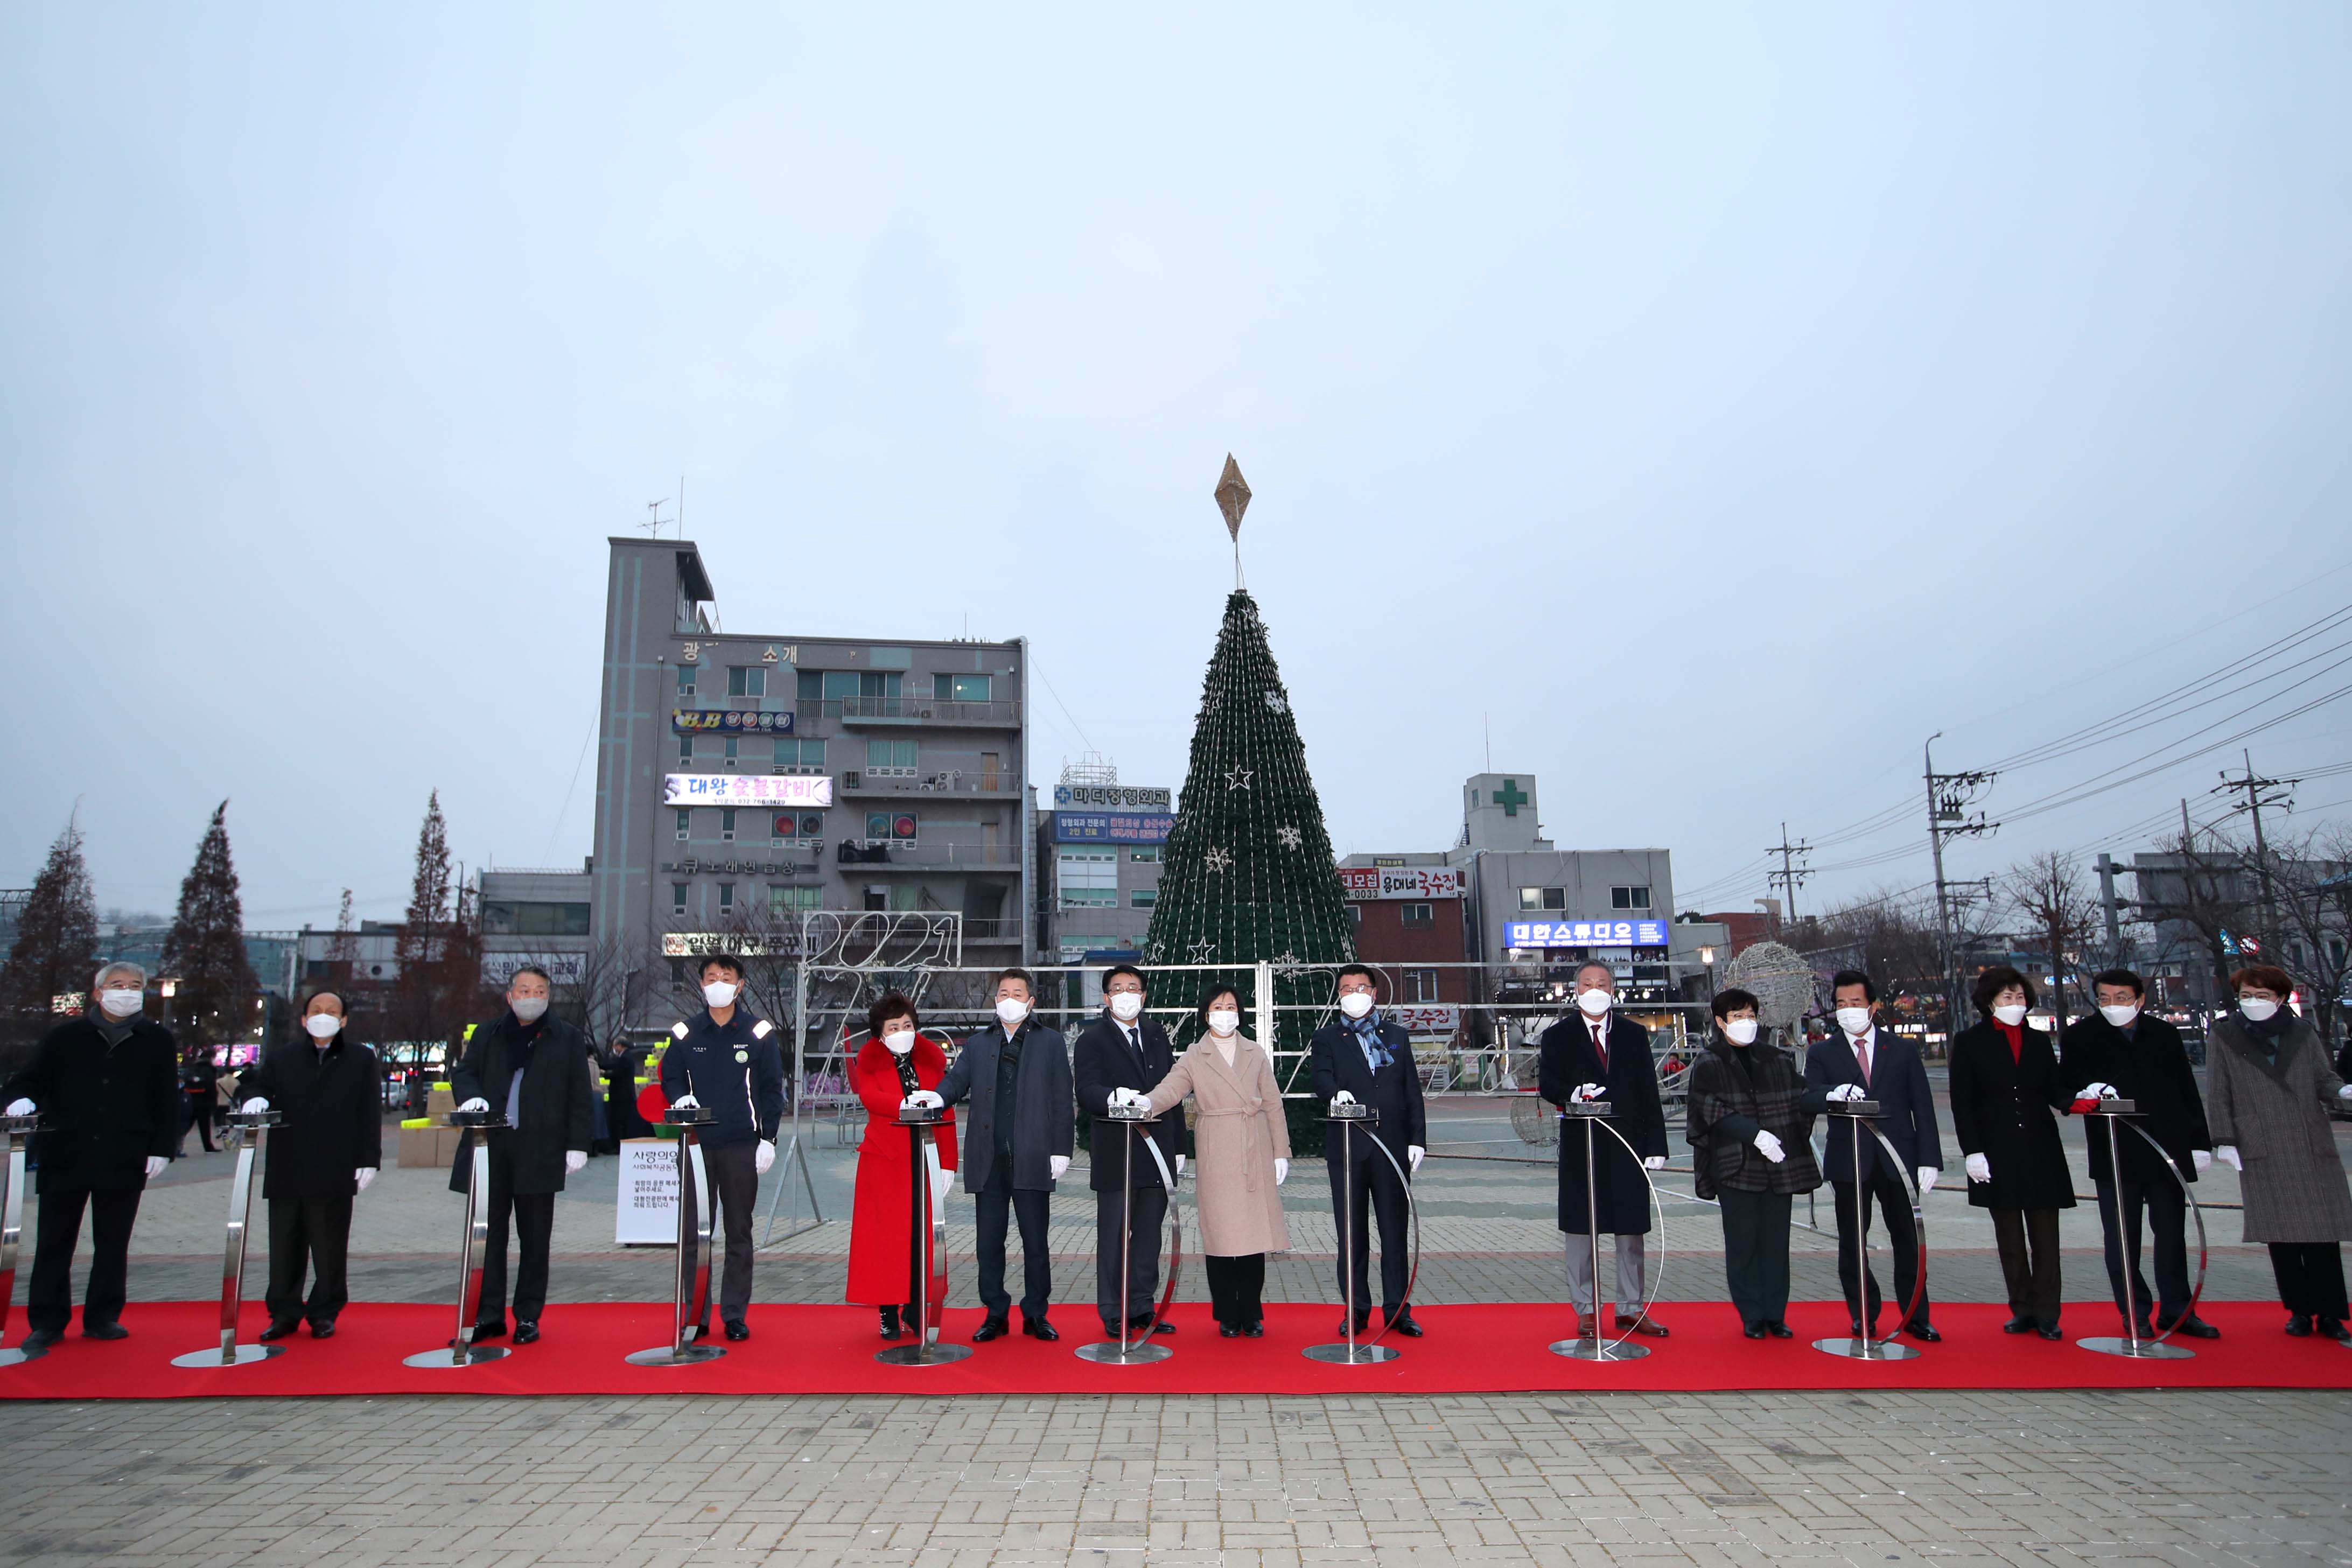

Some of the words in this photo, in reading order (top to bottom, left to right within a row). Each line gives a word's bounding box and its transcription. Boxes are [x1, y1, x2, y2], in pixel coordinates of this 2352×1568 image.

[688, 778, 728, 796] 대왕
[732, 777, 810, 797] 숯불갈비
[1073, 787, 1170, 806] 마디정형외과
[1061, 818, 1085, 827] 정형외과
[1087, 818, 1105, 827] 전문의
[1418, 870, 1455, 897] 국수집
[803, 912, 953, 969] 2021
[1402, 1009, 1450, 1028] 국수집
